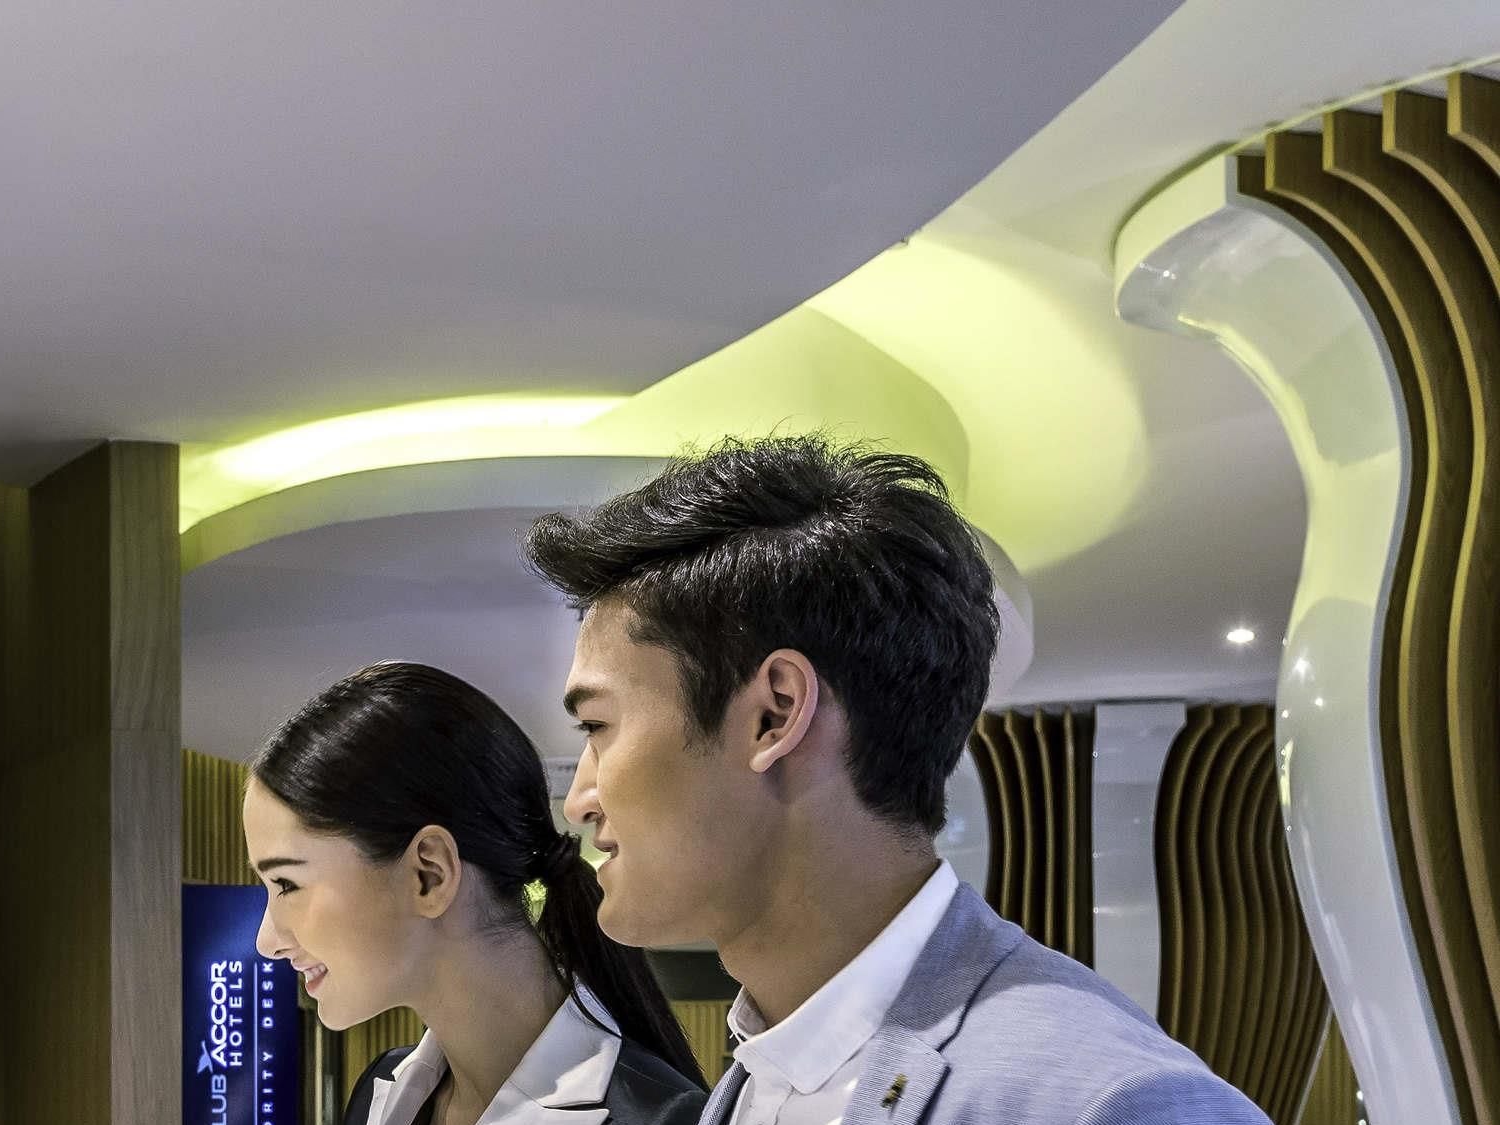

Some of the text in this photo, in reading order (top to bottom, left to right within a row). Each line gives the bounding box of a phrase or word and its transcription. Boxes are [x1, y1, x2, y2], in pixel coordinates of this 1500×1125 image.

[211, 960, 227, 1068] ACCOR
[229, 960, 243, 1067] HOTELS
[262, 962, 274, 1029] DESK
